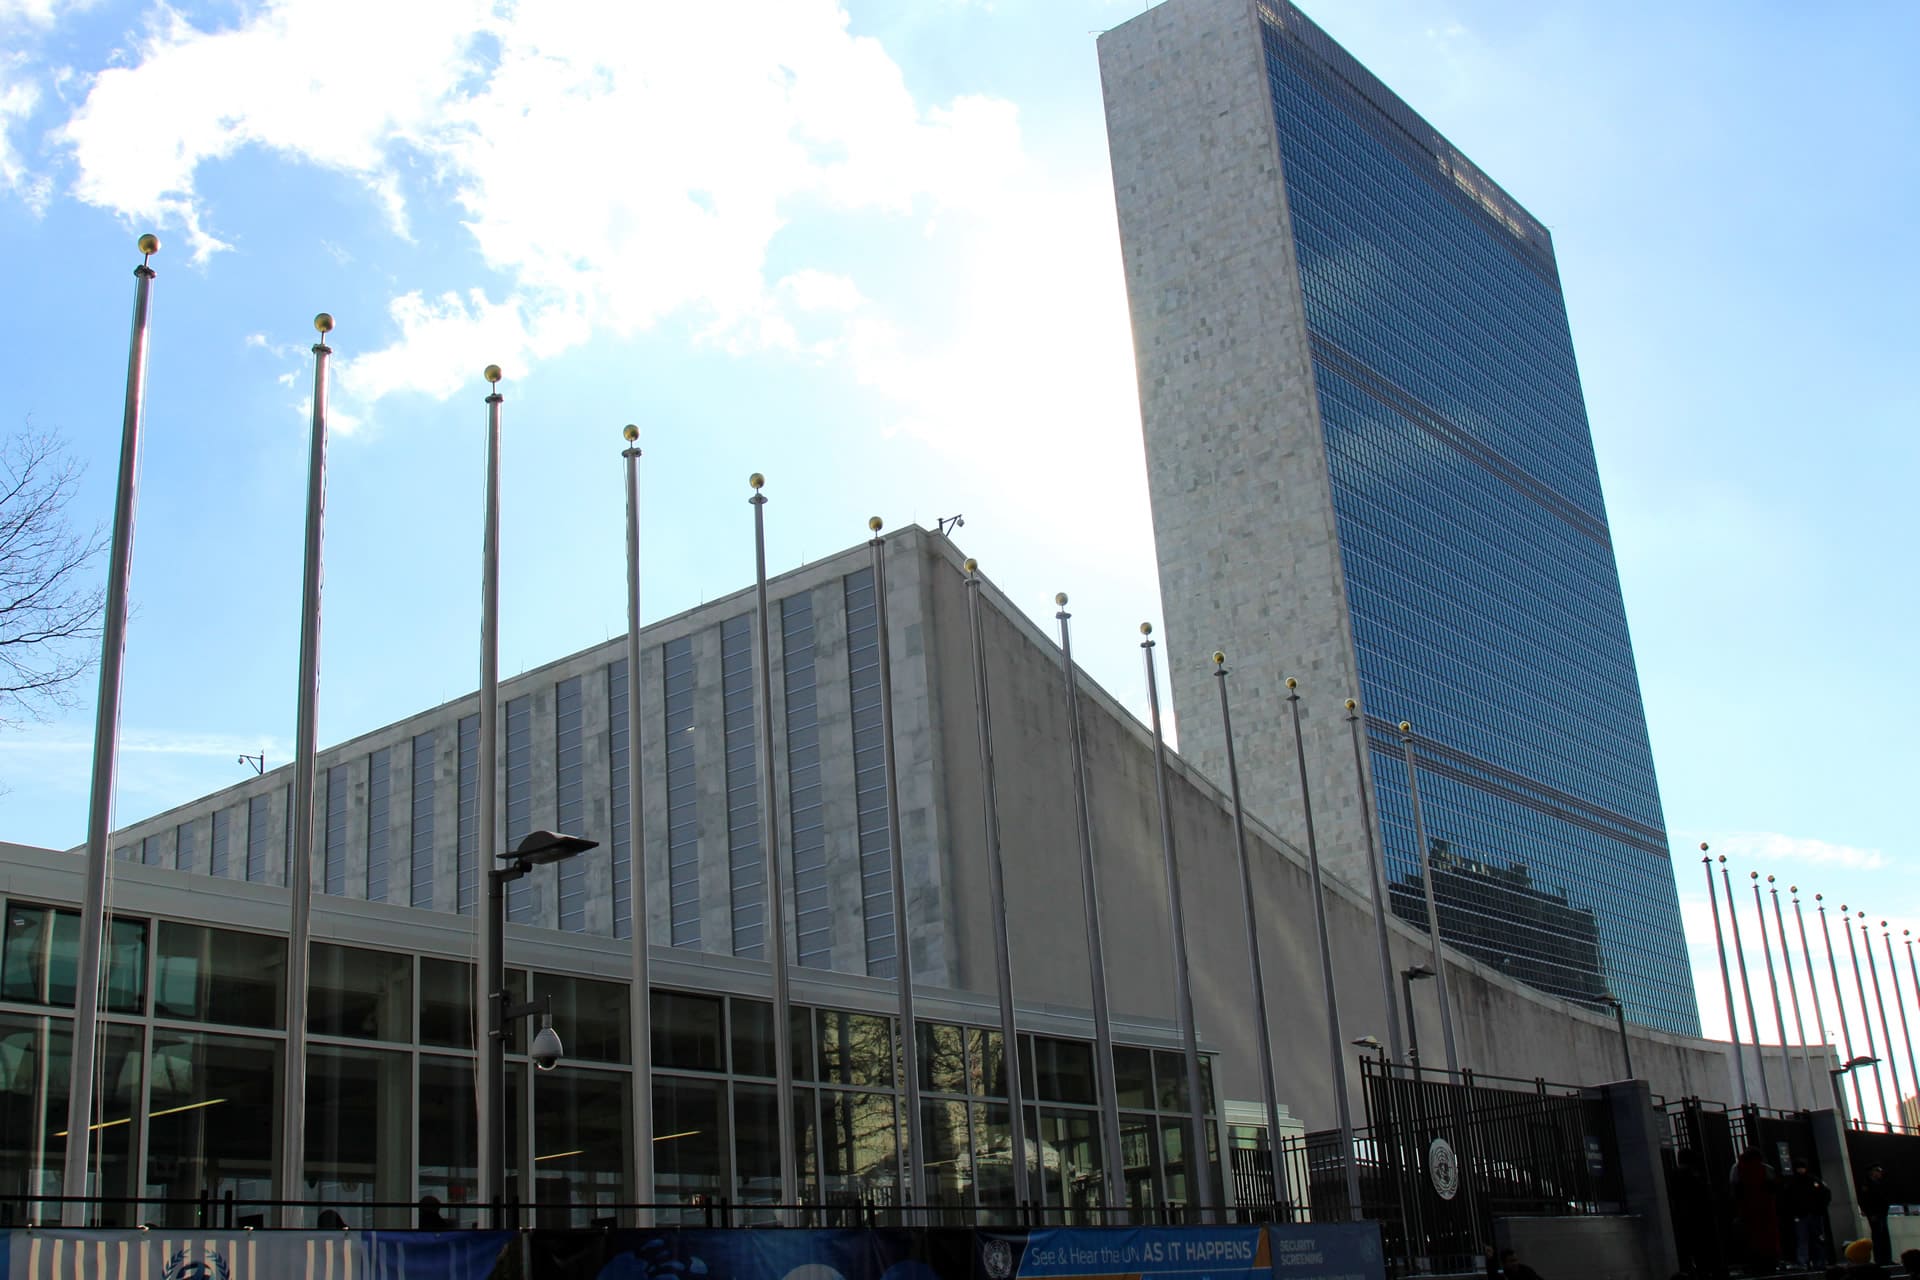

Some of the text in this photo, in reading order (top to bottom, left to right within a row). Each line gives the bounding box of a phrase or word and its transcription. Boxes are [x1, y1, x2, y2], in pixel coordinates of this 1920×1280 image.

[1280, 1239, 1315, 1252] SECURITY
[1031, 1240, 1252, 1266] See & Hear the UN AS IT HAPPENS
[1281, 1252, 1324, 1266] SCREENING
